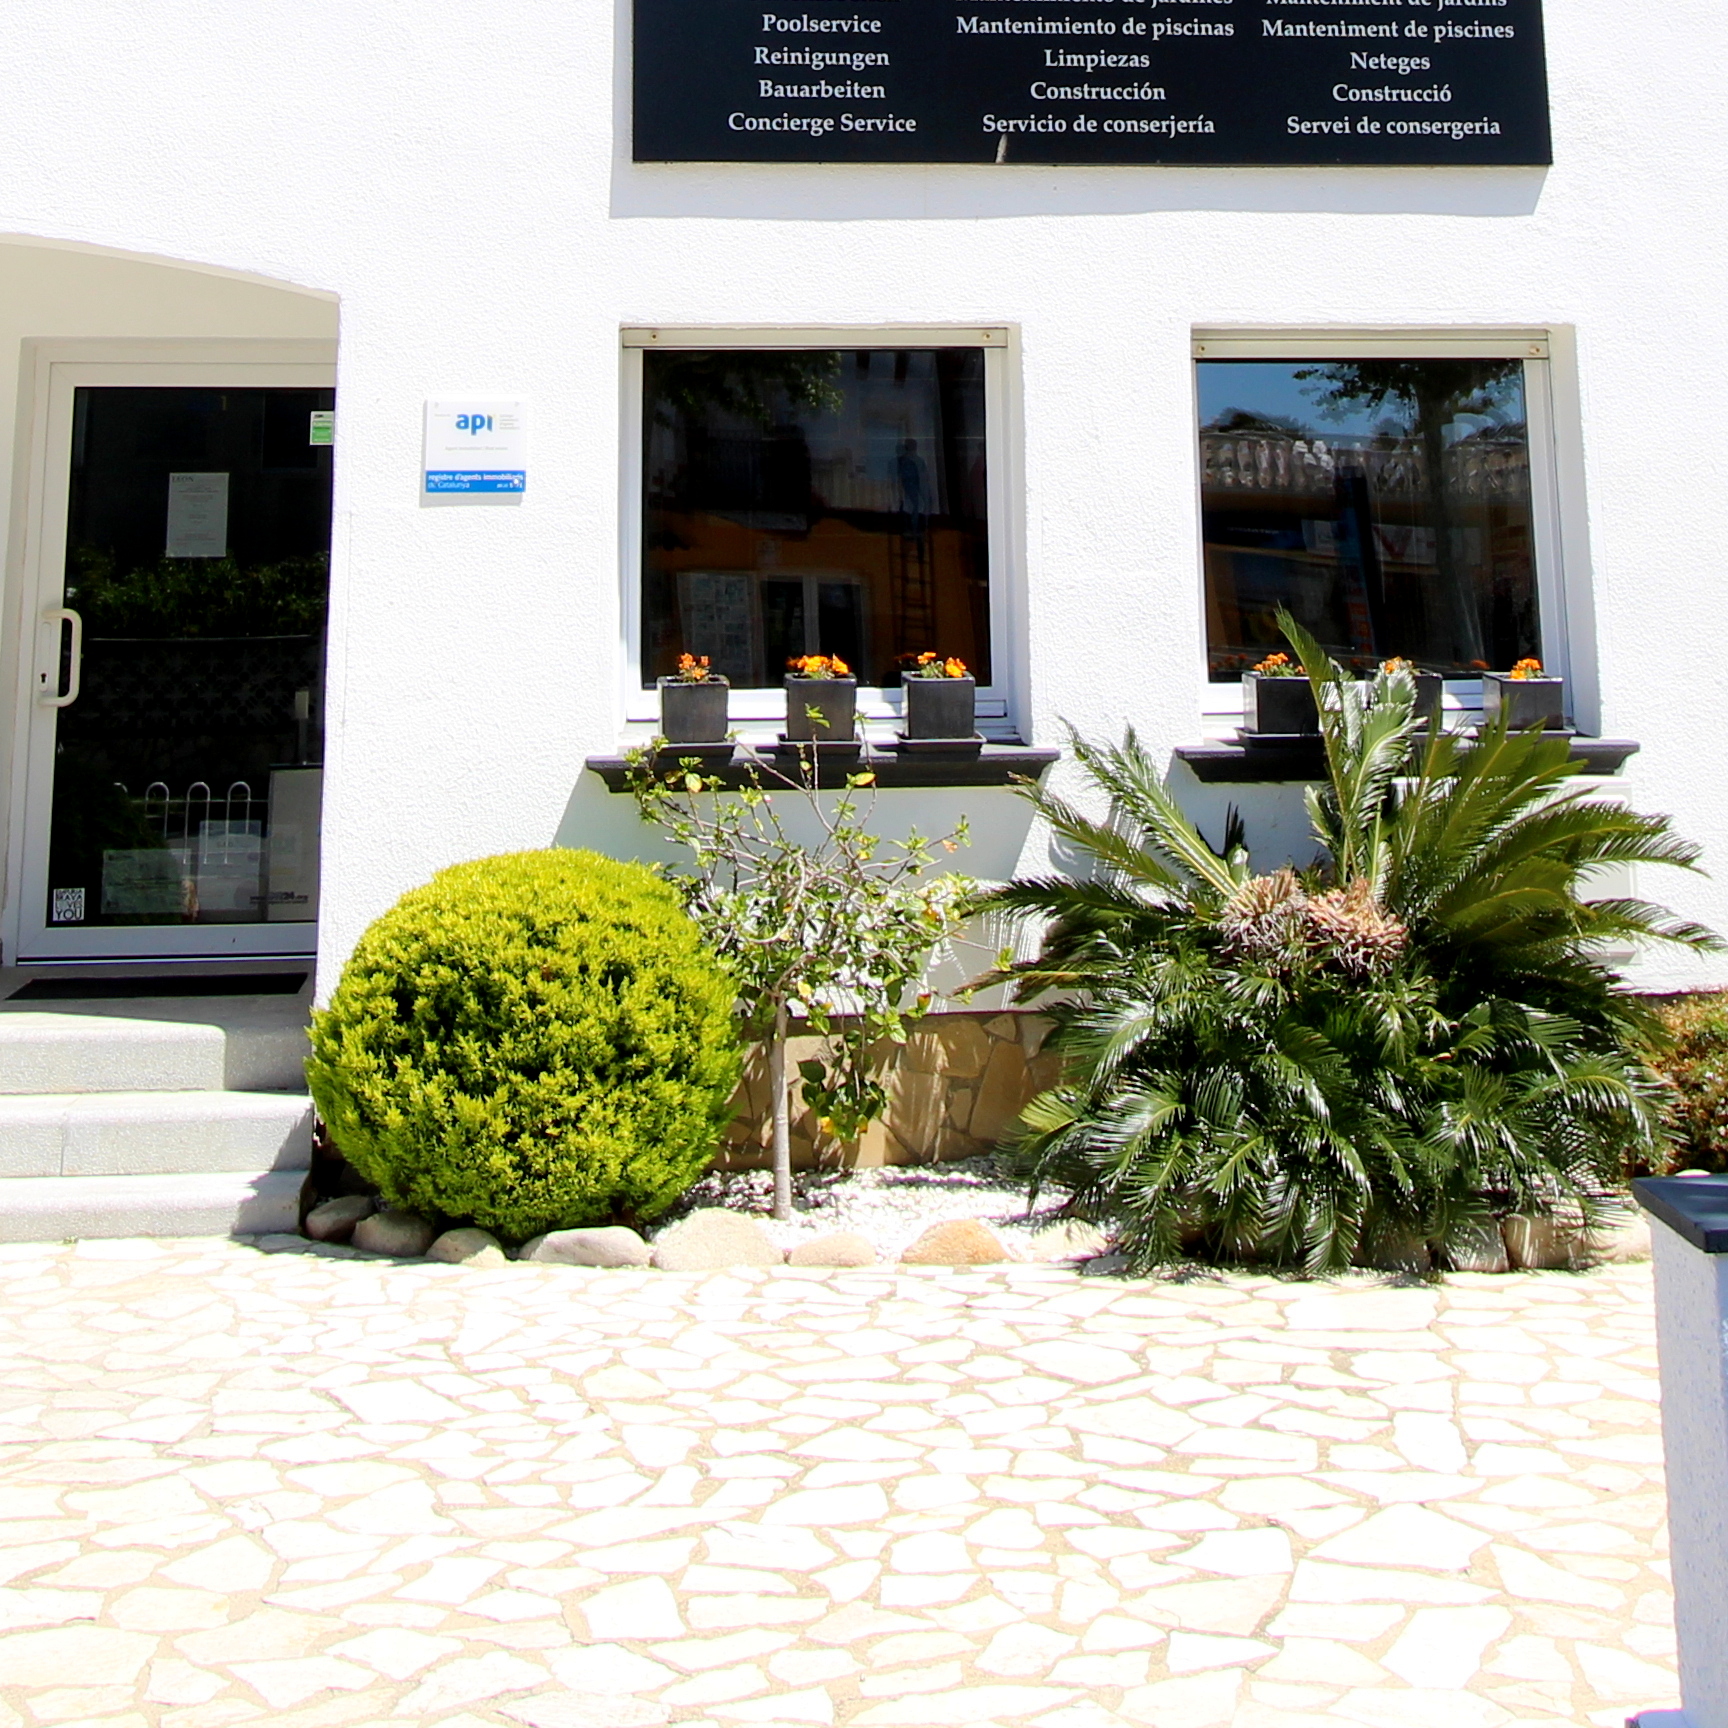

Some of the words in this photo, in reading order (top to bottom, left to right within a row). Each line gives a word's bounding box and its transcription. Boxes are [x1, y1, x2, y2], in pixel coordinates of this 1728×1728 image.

[763, 14, 881, 32] Poolservice
[957, 17, 1115, 34] Mantenimiento
[1122, 17, 1146, 35] de
[1152, 18, 1234, 40] piscinas
[1262, 20, 1398, 37] Manteniment
[1405, 20, 1427, 37] de
[1434, 21, 1514, 42] piscines
[755, 47, 889, 70] Reinigungen
[1045, 49, 1149, 72] Limpiezas
[1351, 52, 1430, 74] Neteges
[759, 80, 885, 98] Bauarbeiten
[1031, 82, 1166, 100] Construcción
[1333, 84, 1451, 102] Construcció
[729, 113, 834, 136] Concierge
[841, 114, 916, 131] Service
[983, 115, 1066, 132] Servicio
[1073, 115, 1097, 132] de
[1104, 115, 1215, 138] conserjería
[1288, 116, 1350, 133] Servei
[1357, 116, 1380, 133] de
[1387, 117, 1500, 139] consergeria
[456, 414, 493, 436] api
[55, 909, 82, 920] YOU
